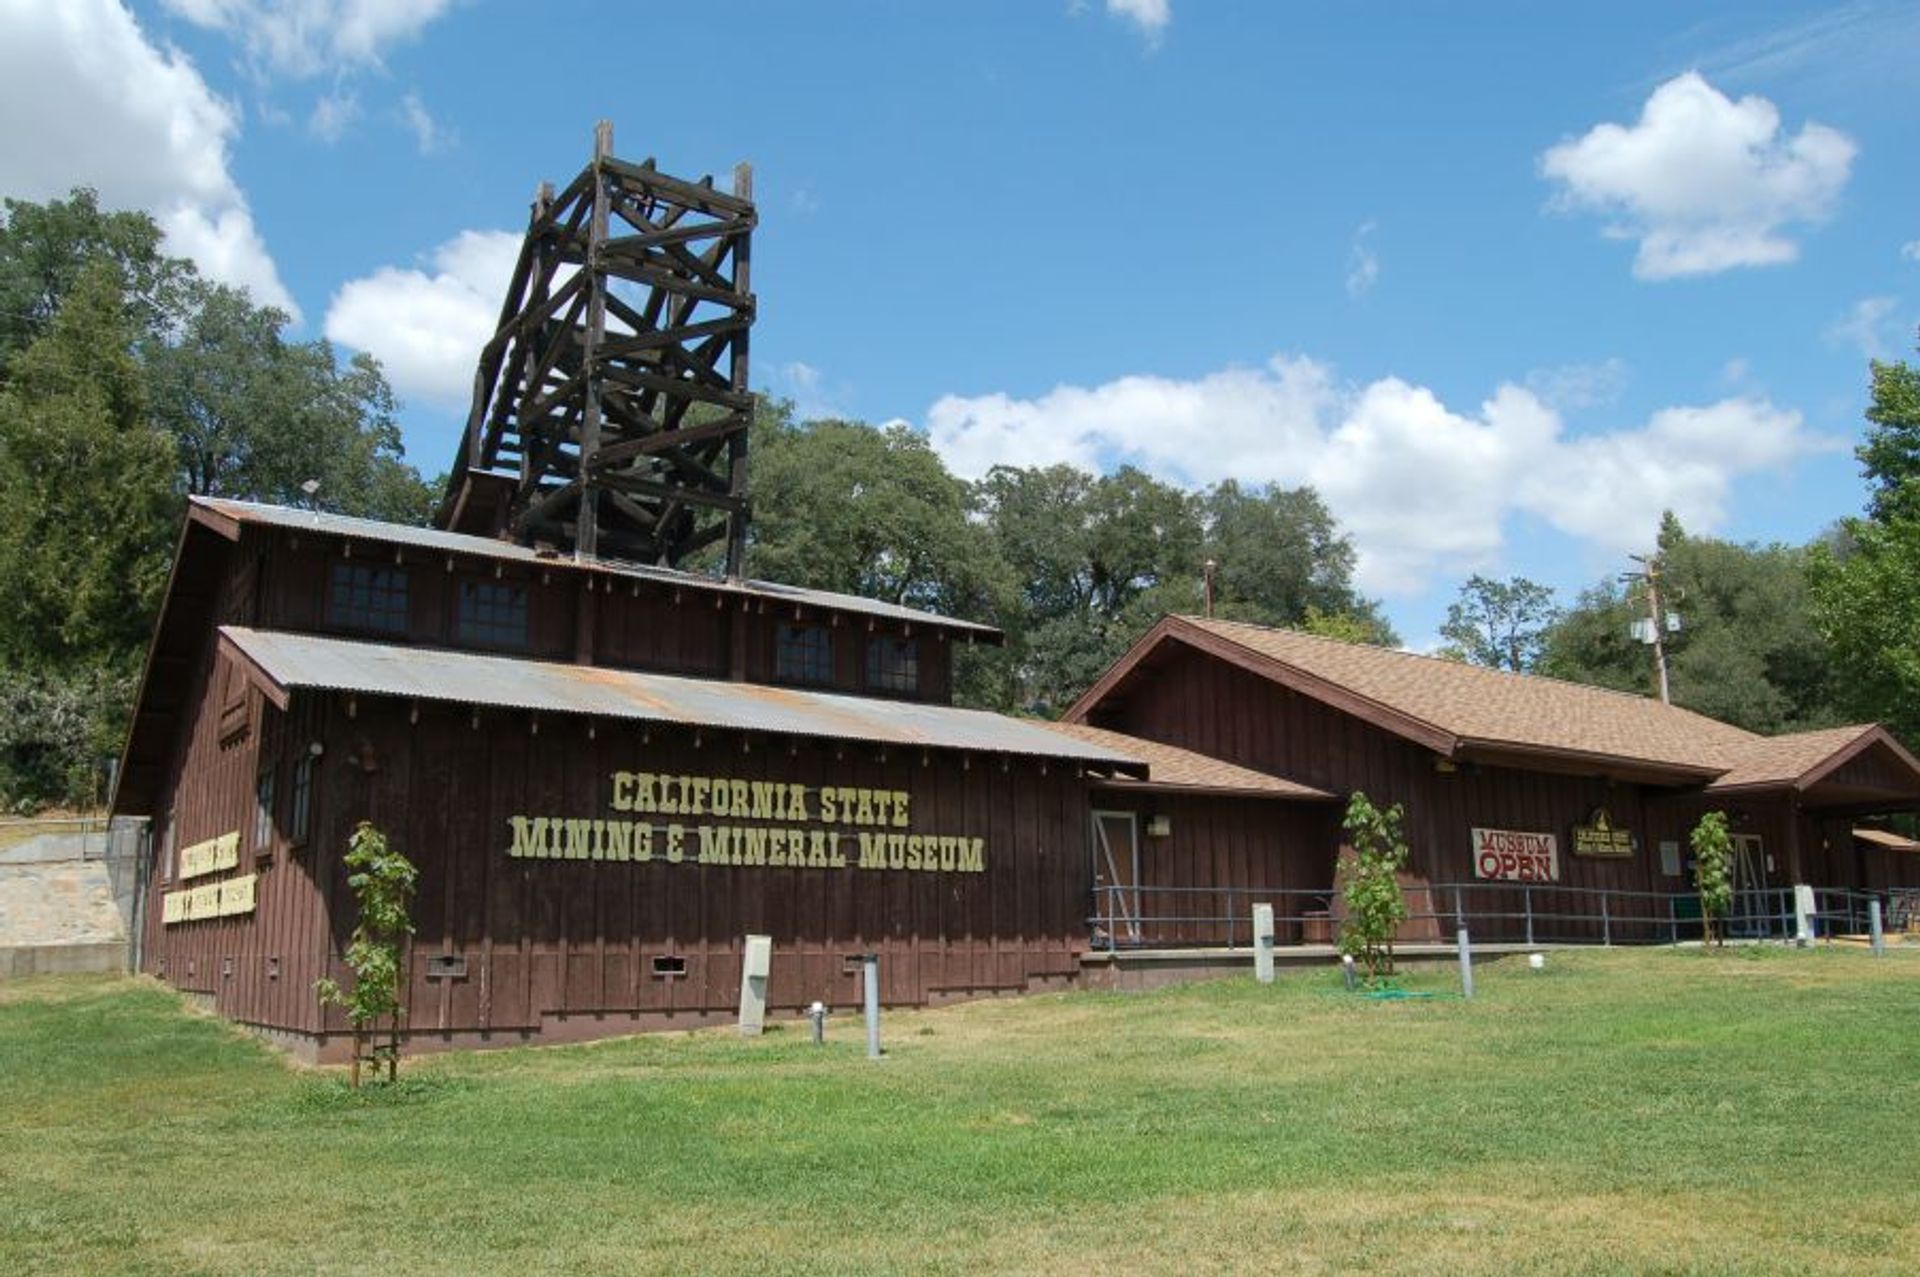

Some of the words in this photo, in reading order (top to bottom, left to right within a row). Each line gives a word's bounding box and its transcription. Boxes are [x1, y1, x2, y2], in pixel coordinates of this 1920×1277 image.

[614, 771, 808, 821] CALIFORNIA
[820, 786, 909, 827] STATE
[511, 815, 653, 862] MINING
[666, 823, 685, 863] &
[698, 825, 846, 868] MINERAL
[858, 832, 985, 873] MUSEUM
[1479, 831, 1551, 855] MUSEUM
[1479, 851, 1552, 881] OPEN
